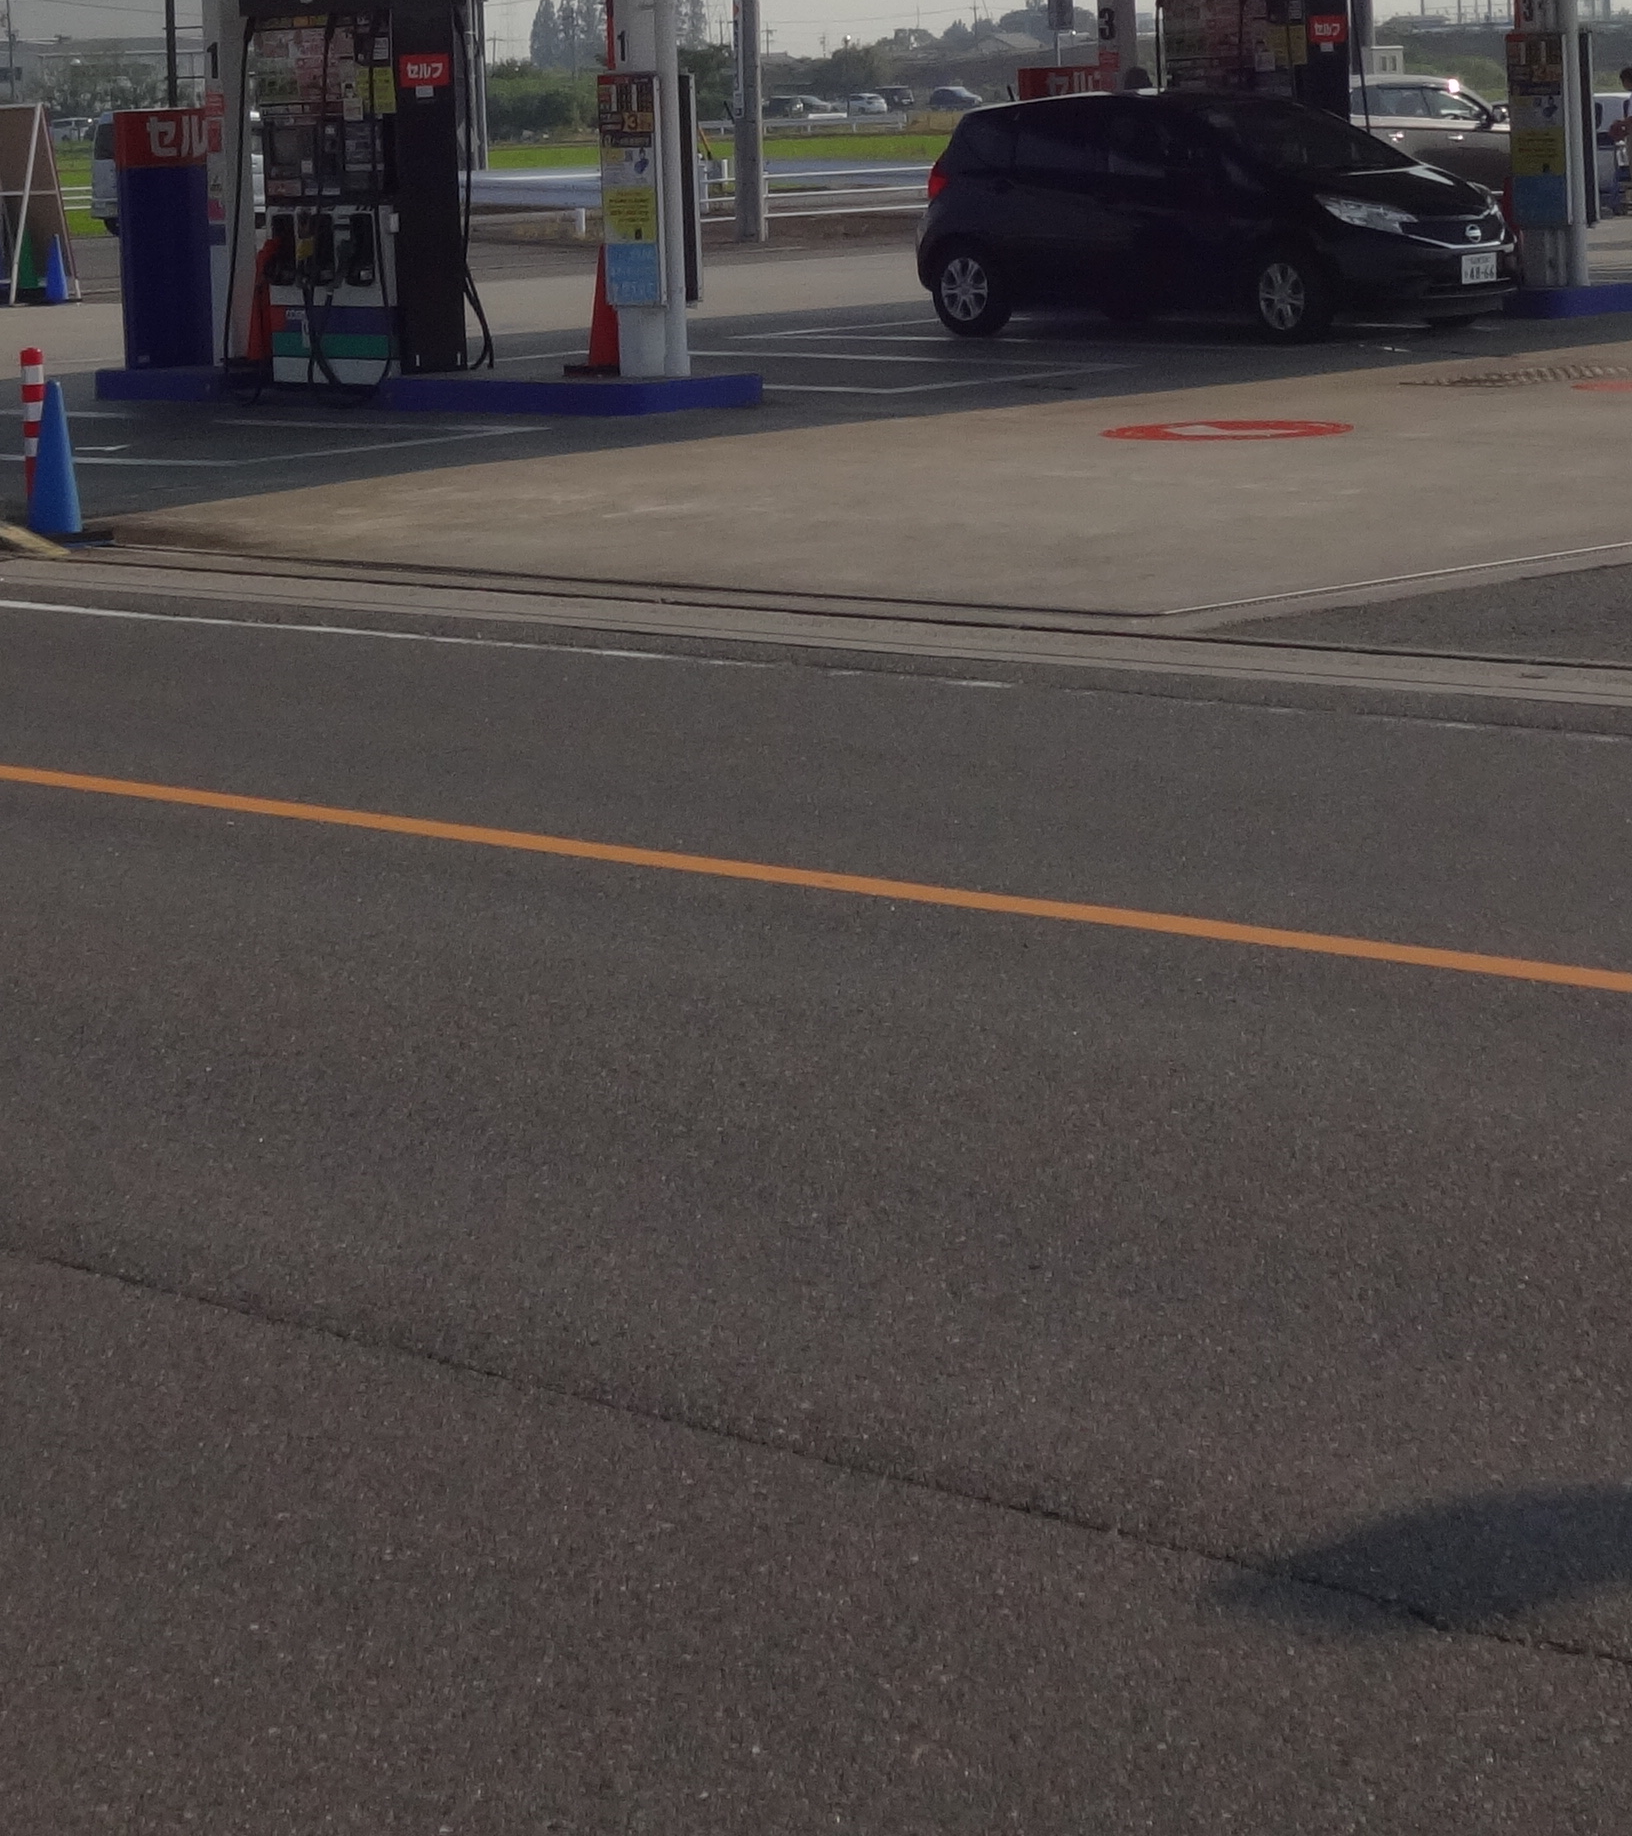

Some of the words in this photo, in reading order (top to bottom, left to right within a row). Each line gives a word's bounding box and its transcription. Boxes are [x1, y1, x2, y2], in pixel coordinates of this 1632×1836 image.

[1098, 7, 1116, 40] 3
[1314, 23, 1341, 36] セルフ
[406, 62, 444, 80] セルフ
[146, 116, 207, 158] セル
